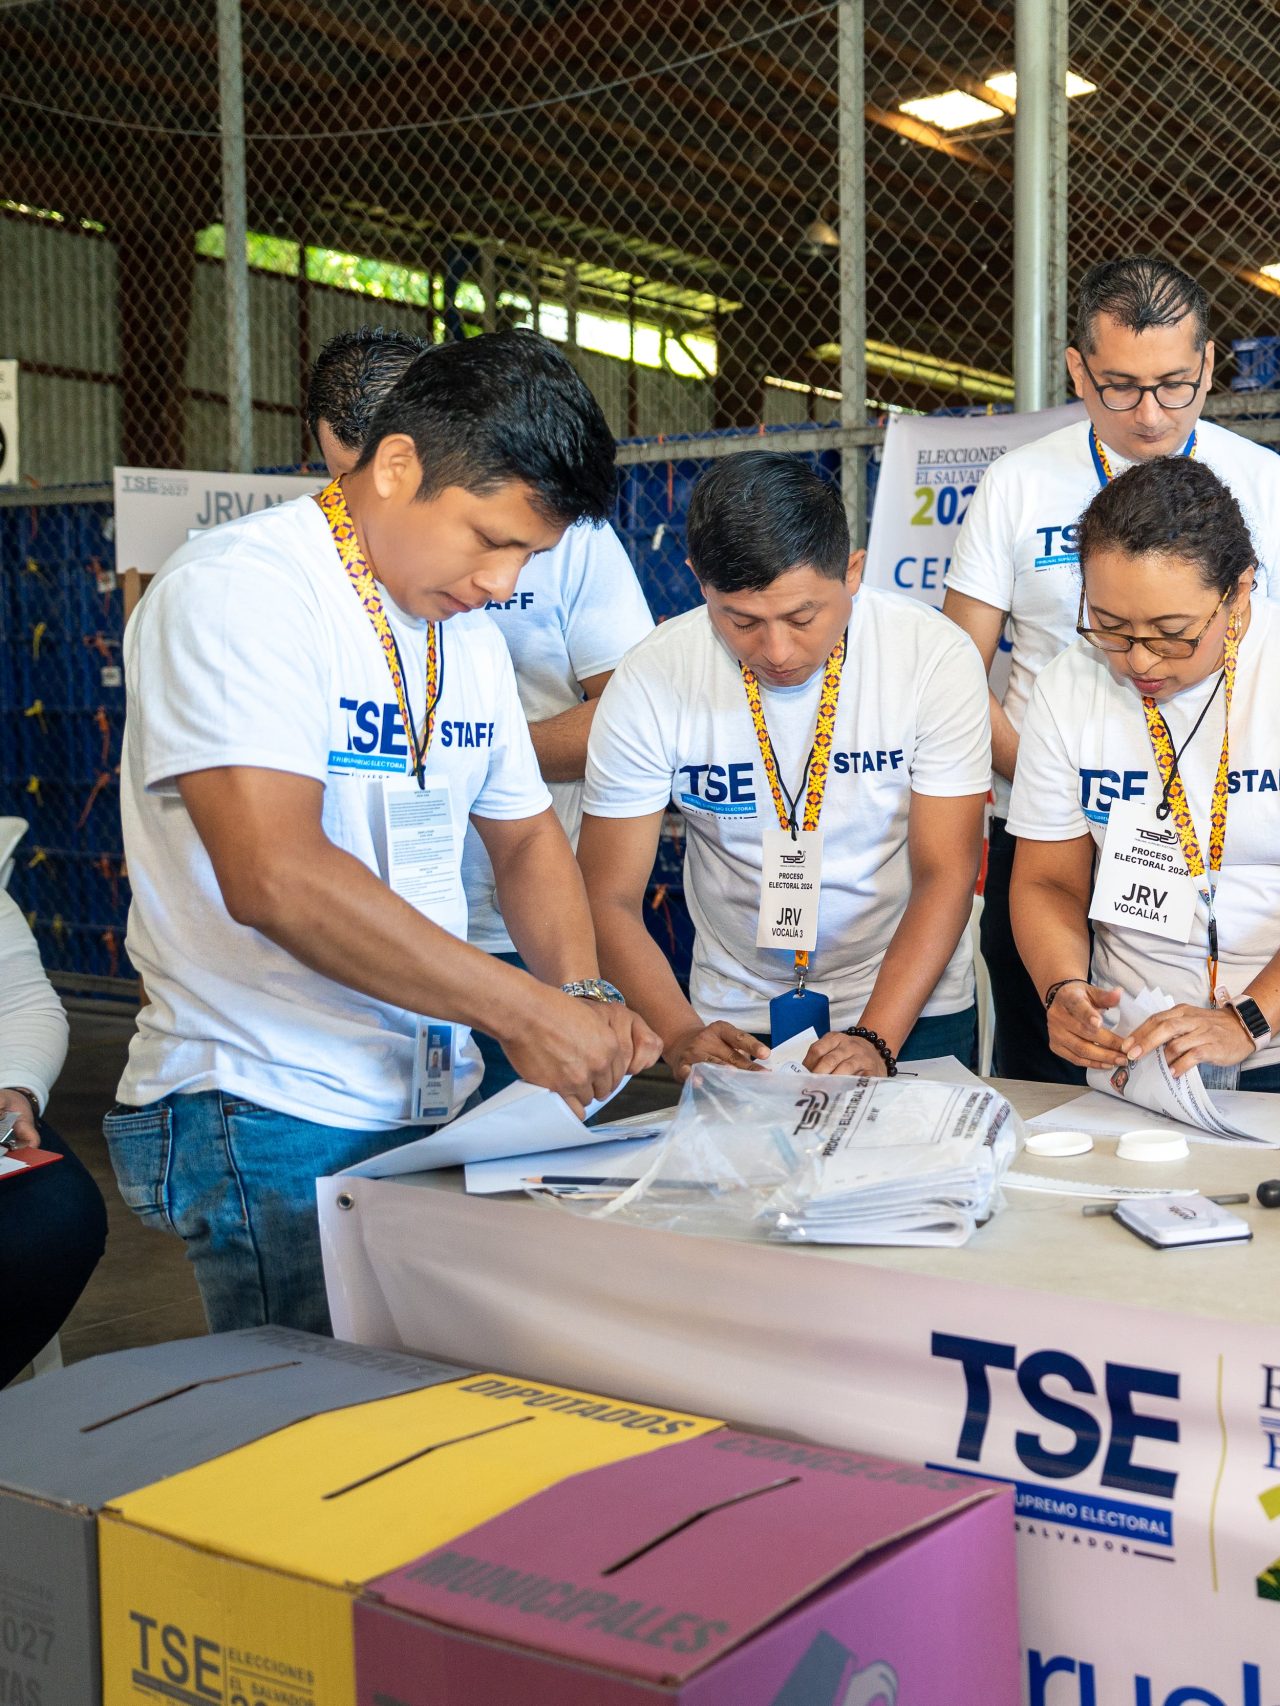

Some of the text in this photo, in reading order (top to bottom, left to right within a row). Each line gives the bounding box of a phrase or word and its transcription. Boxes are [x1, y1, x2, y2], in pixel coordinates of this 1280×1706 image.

[918, 446, 1007, 465] ELECCIONES
[122, 476, 158, 490] TSE
[916, 471, 932, 486] EL
[196, 490, 254, 525] JRV
[1036, 525, 1080, 557] TS
[484, 592, 534, 611] AFF
[340, 697, 408, 756] TSE
[834, 749, 904, 774] STAFF
[679, 762, 756, 803] TSE
[1114, 852, 1189, 877] ELECTORAL 2024
[1132, 846, 1174, 863] PROCESO
[768, 882, 800, 890] ELECTORAL
[778, 872, 804, 880] PROCESO
[1122, 883, 1169, 909] JRV
[776, 908, 802, 926] JRV
[1114, 902, 1168, 924] VOCALÍA 1
[772, 927, 804, 938] VOCALÍA 3
[457, 1378, 697, 1437] DIPUTADOS
[932, 1330, 1180, 1499] TSE
[1016, 1494, 1169, 1537] UPREMO ELECTORAL
[406, 1551, 731, 1655] MUNICIPALES
[2, 1617, 56, 1666] 027
[130, 1609, 222, 1700] TSE
[228, 1648, 314, 1685] ELECCIONES
